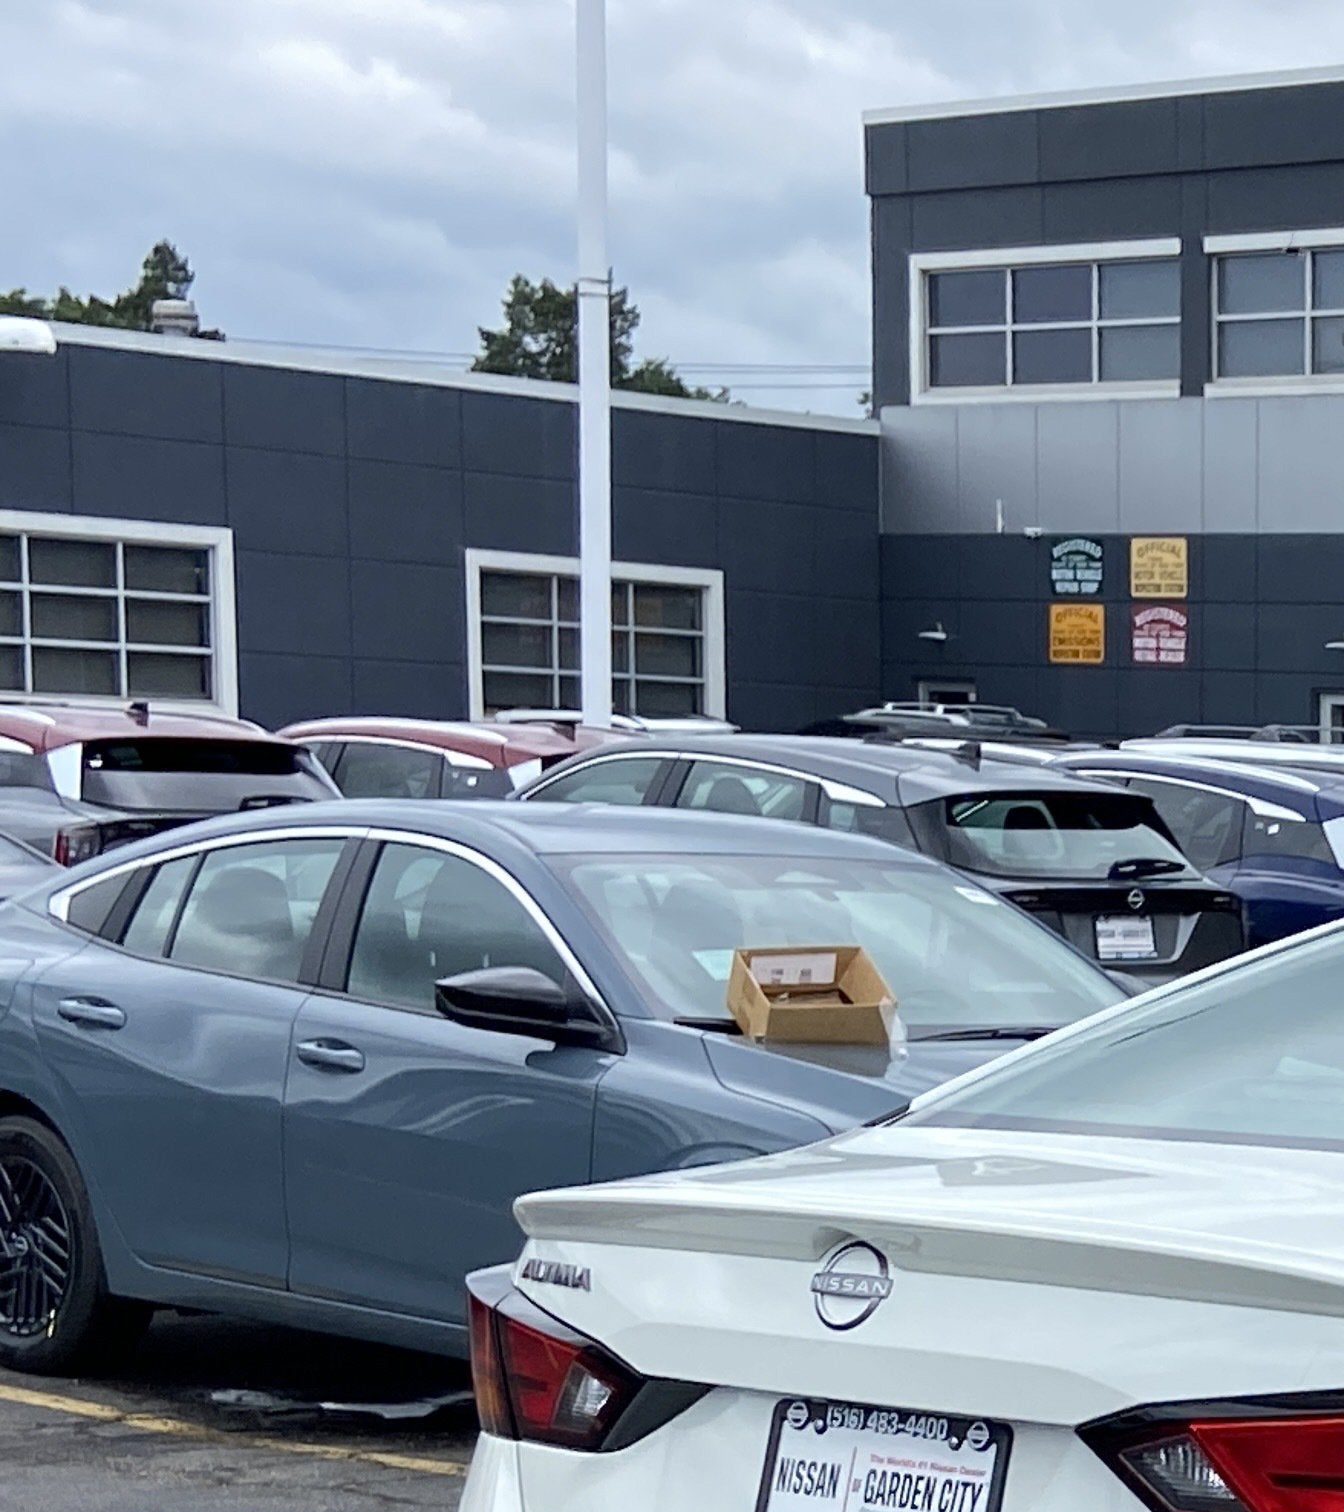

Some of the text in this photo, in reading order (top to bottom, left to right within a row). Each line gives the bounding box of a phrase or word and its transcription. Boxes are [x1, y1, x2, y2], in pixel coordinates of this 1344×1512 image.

[1136, 541, 1182, 559] OFFICIAL
[1055, 607, 1098, 624] OFFICIAL
[522, 1259, 591, 1292] ALTIMA
[814, 1275, 889, 1295] NISSAN
[826, 1406, 949, 1440] (516) 483-4400
[775, 1457, 841, 1499] NISSAN
[864, 1468, 937, 1512] GARDEN
